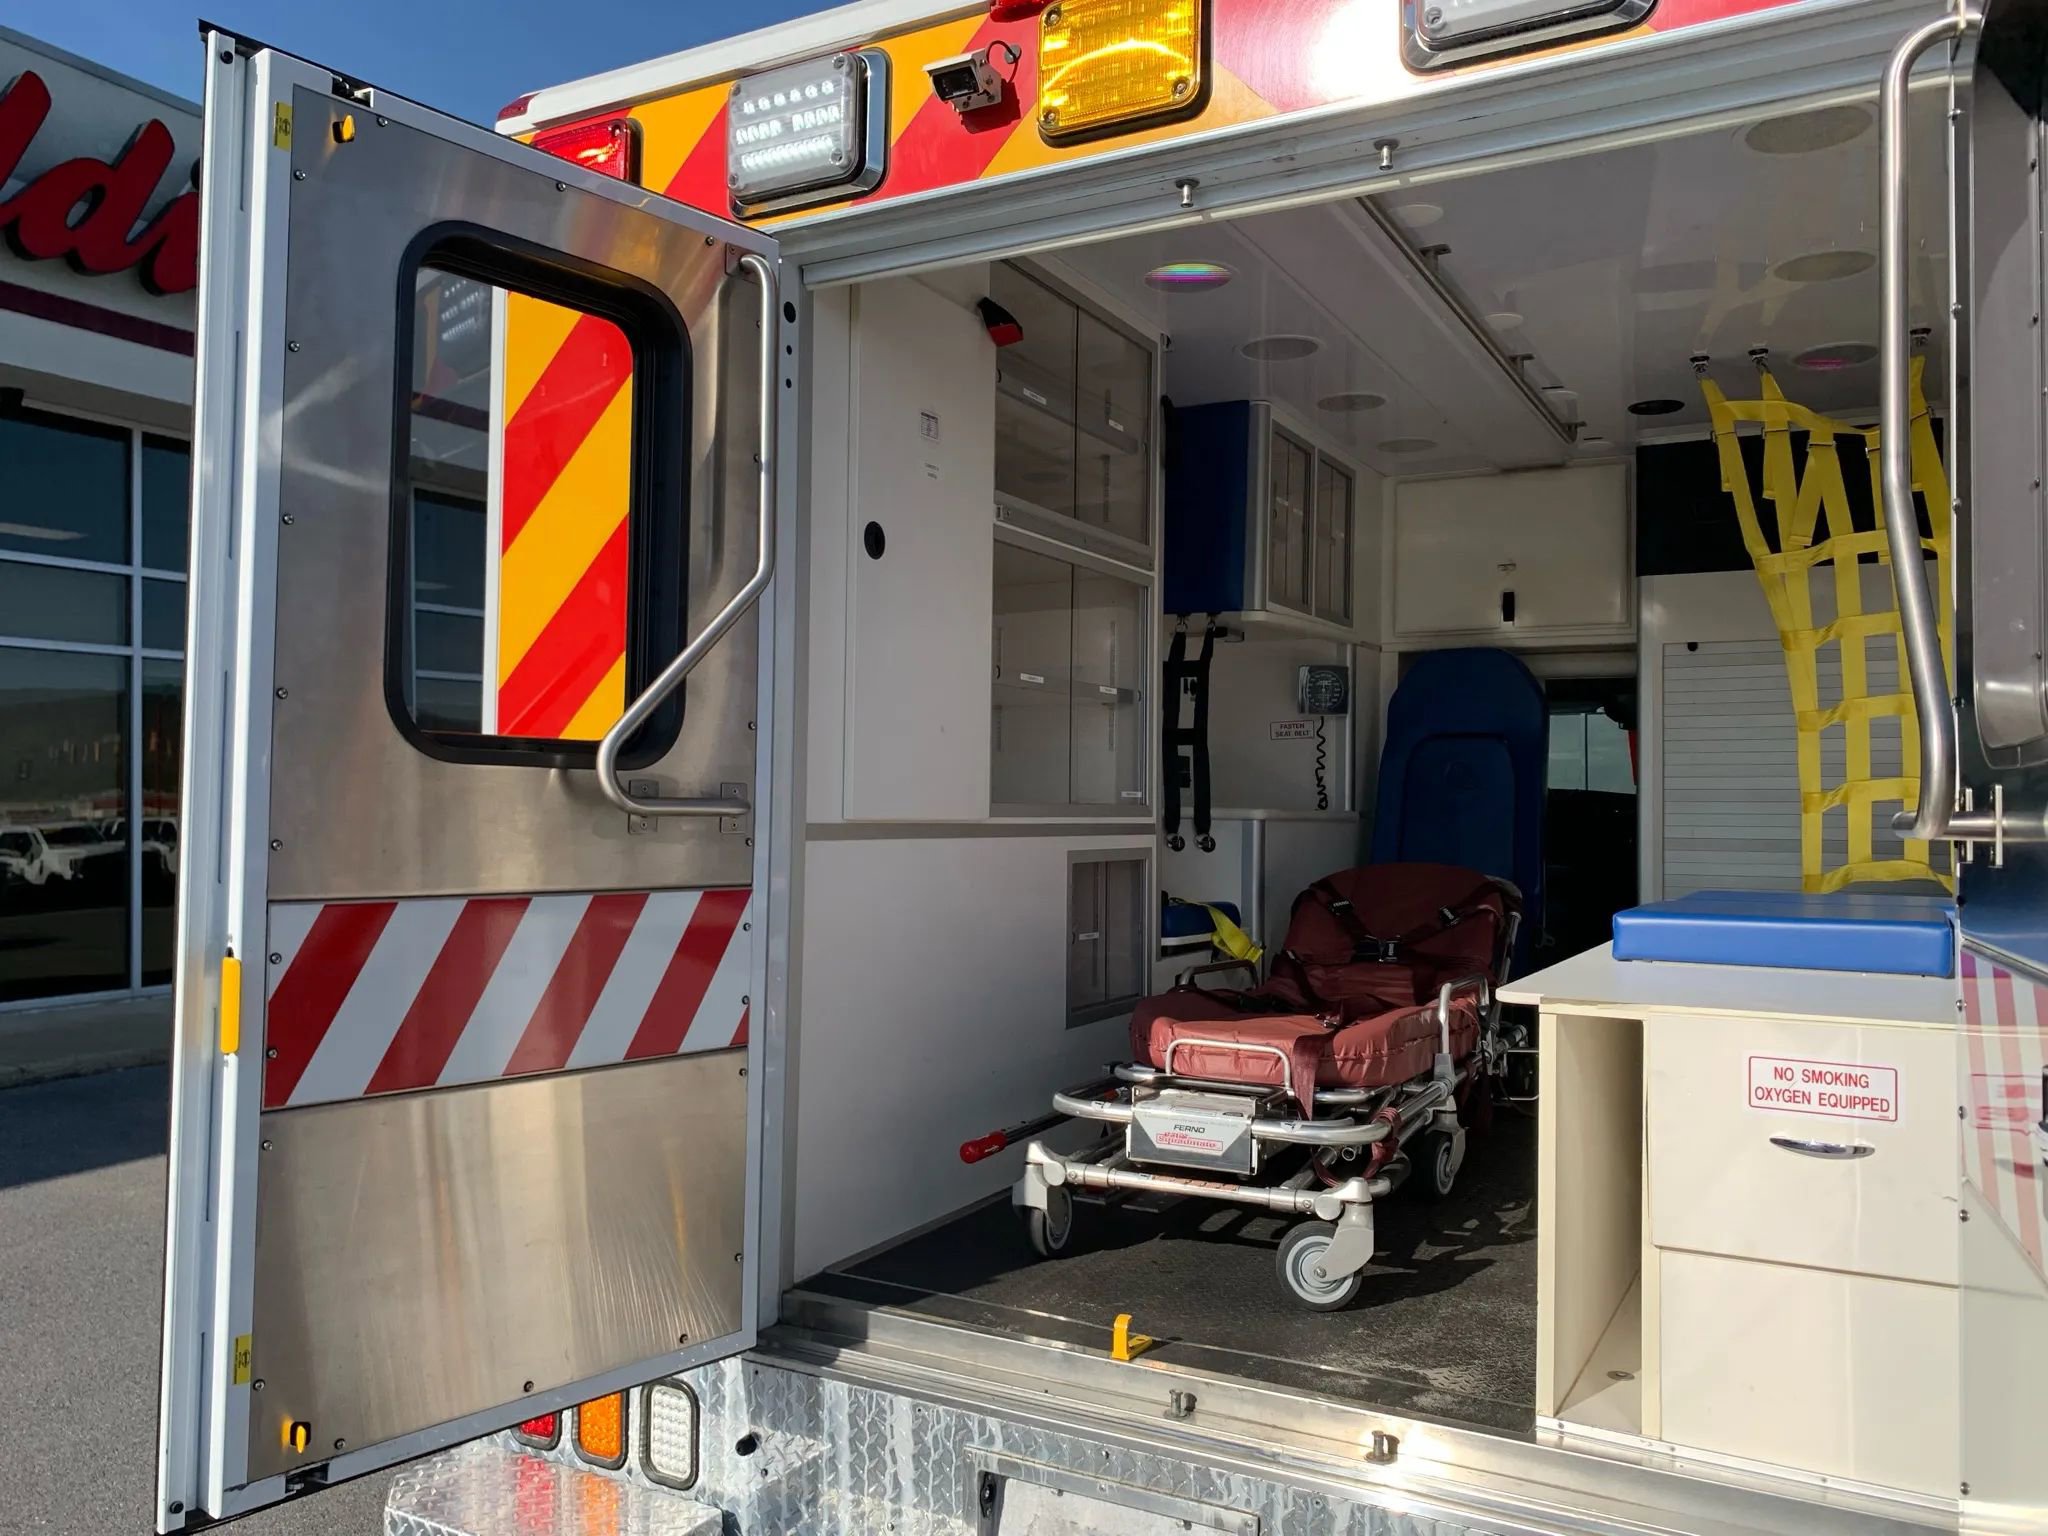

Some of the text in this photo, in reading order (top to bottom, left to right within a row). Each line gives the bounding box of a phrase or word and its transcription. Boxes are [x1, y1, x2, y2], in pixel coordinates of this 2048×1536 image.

[1774, 1066, 1870, 1089] NO SMOKING
[1754, 1086, 1890, 1113] OXYGEN EQUIPPED
[1173, 1124, 1206, 1134] FERNO
